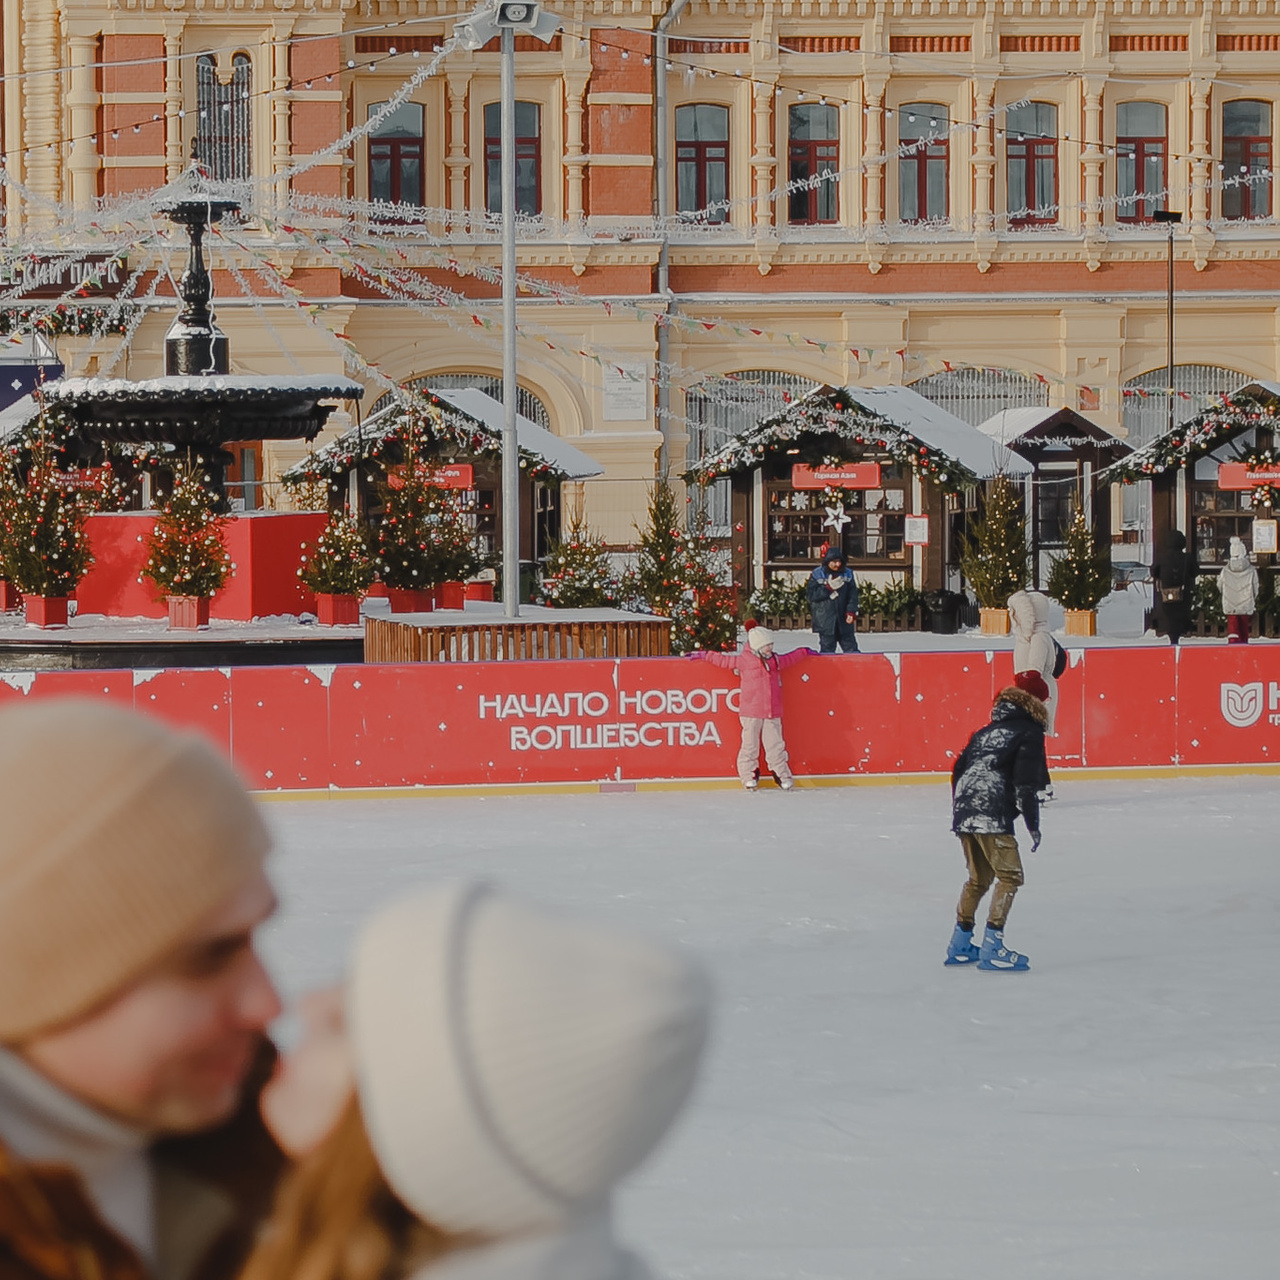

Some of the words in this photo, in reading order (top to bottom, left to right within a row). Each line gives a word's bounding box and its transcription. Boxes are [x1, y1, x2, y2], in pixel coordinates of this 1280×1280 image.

[70, 261, 119, 284] ПАРК
[478, 692, 610, 720] НАЧАЛО
[510, 720, 722, 751] ВОЛШЕБСТВА
